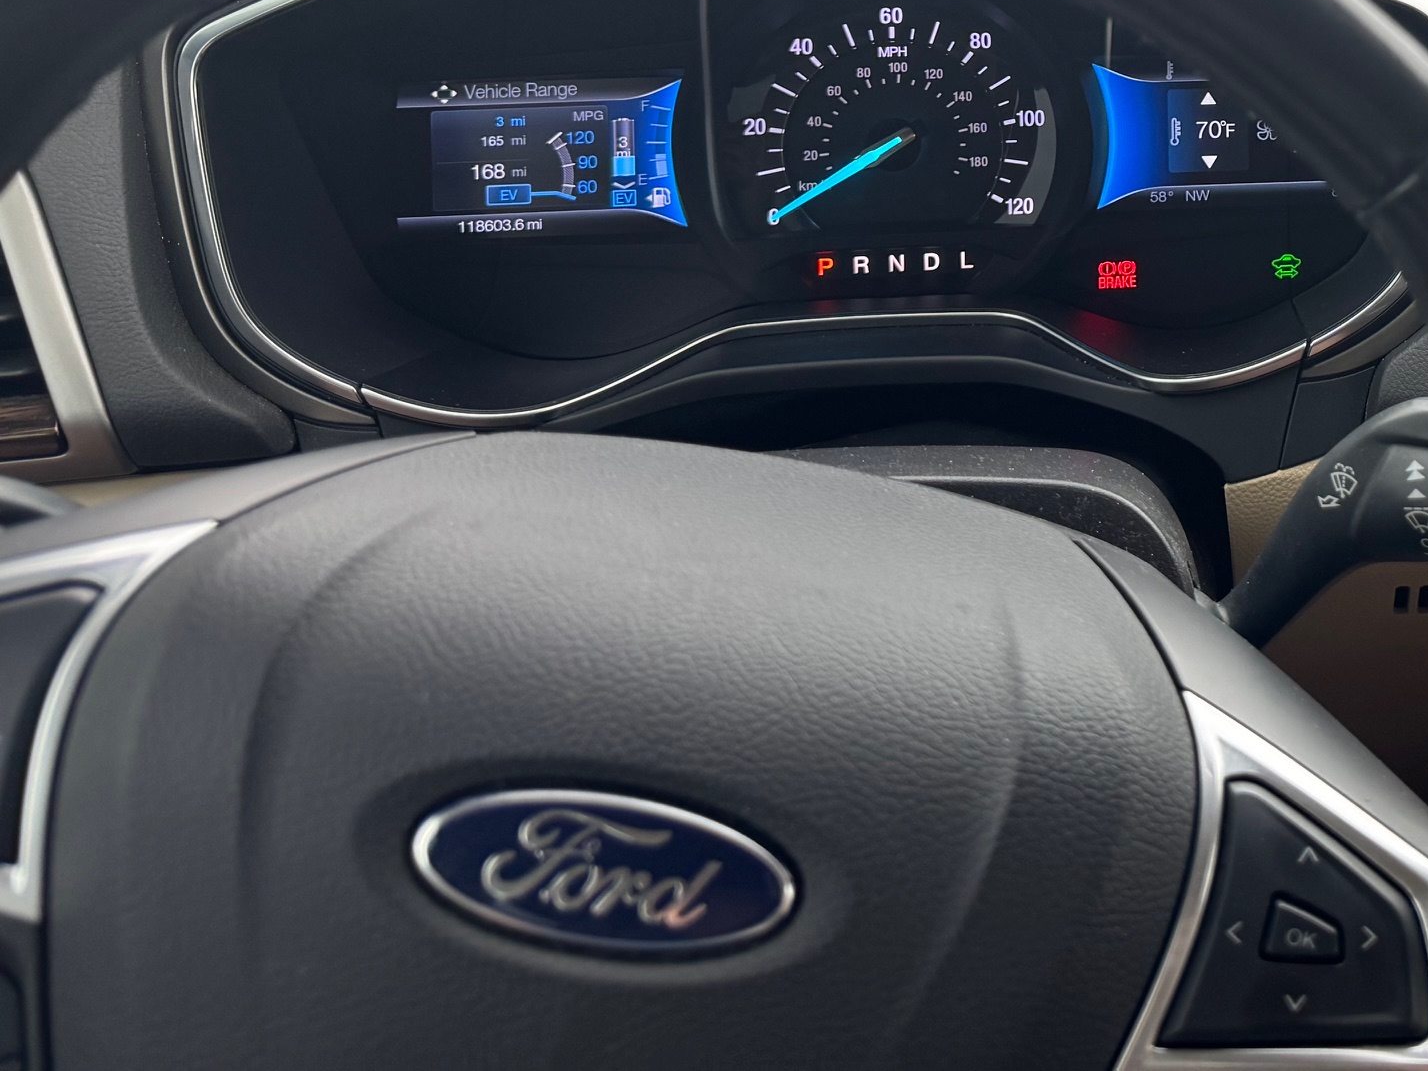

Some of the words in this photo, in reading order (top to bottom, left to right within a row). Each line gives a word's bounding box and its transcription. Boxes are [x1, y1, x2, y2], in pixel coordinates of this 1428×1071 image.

[879, 7, 903, 25] 60
[790, 38, 814, 56] 40
[969, 32, 992, 49] 80
[877, 46, 908, 58] MPH
[856, 67, 871, 79] 80
[888, 62, 908, 74] 100
[924, 68, 944, 79] 120
[464, 84, 522, 100] Vehicle
[525, 82, 579, 99] Range
[826, 85, 842, 97] 60
[953, 90, 973, 103] 140
[641, 100, 650, 112] F
[496, 116, 505, 127] 3
[511, 115, 526, 127] mi
[573, 110, 604, 123] MPG
[806, 116, 822, 128] 40
[1016, 110, 1046, 127] 100
[743, 118, 767, 136] 20
[968, 122, 988, 135] 160
[480, 136, 504, 148] 165
[511, 135, 527, 146] mi
[566, 131, 595, 145] 120
[618, 136, 628, 148] 3
[577, 155, 598, 169] 90
[803, 149, 819, 162] 20
[969, 156, 989, 168] 180
[470, 164, 506, 180] 168
[511, 166, 527, 177] mi
[638, 174, 648, 186] E
[577, 180, 598, 194] 60
[500, 189, 518, 201] EV
[615, 192, 633, 204] EV
[1149, 190, 1174, 203] 58°
[1185, 189, 1210, 202] NW
[1005, 198, 1034, 215] 120
[766, 208, 780, 225] 0
[457, 218, 525, 233] 118603.6
[526, 217, 543, 231] mi
[817, 258, 834, 276] P
[853, 255, 870, 274] R
[888, 254, 905, 272] N
[923, 252, 940, 271] D
[960, 251, 974, 269] L
[1098, 275, 1137, 289] BRAKE
[481, 809, 723, 928] Ford
[1285, 928, 1317, 949] OK
